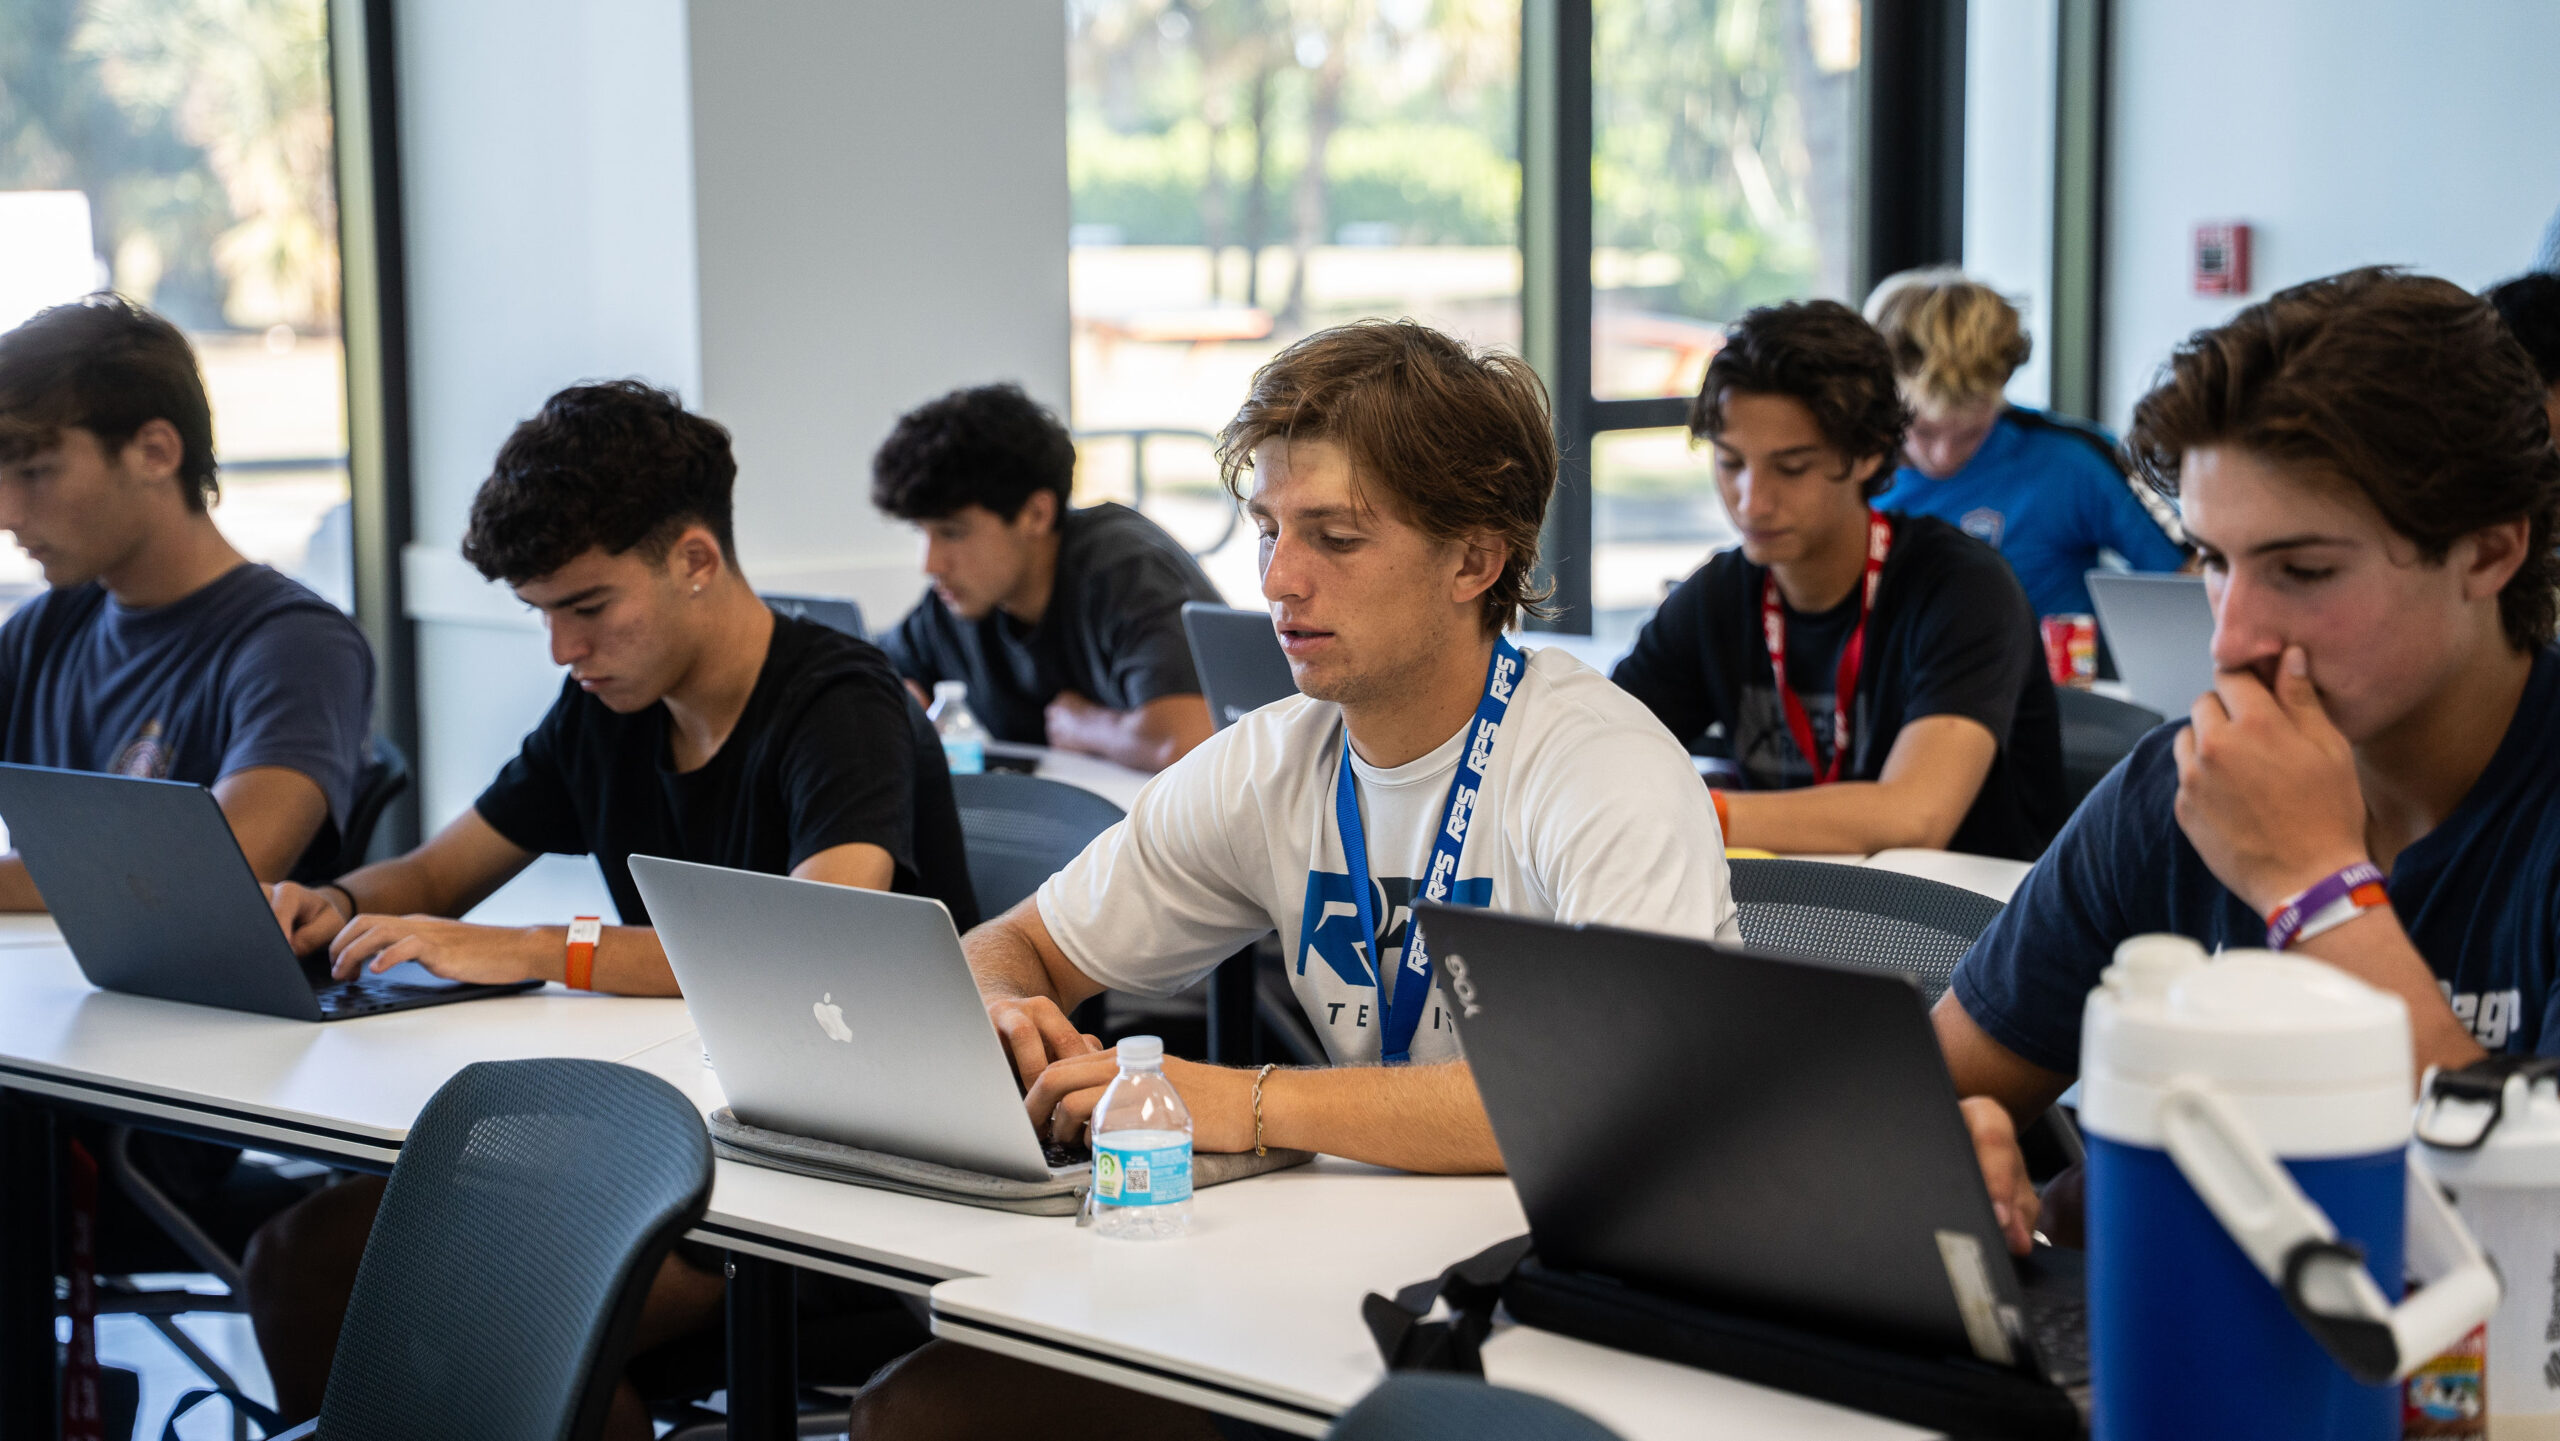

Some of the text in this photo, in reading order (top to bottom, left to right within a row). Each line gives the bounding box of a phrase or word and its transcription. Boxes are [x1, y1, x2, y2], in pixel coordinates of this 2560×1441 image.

[1490, 653, 1517, 704] RPS
[1466, 718, 1500, 777] RPS
[1446, 784, 1477, 843] RPS
[1425, 849, 1455, 905] RPS
